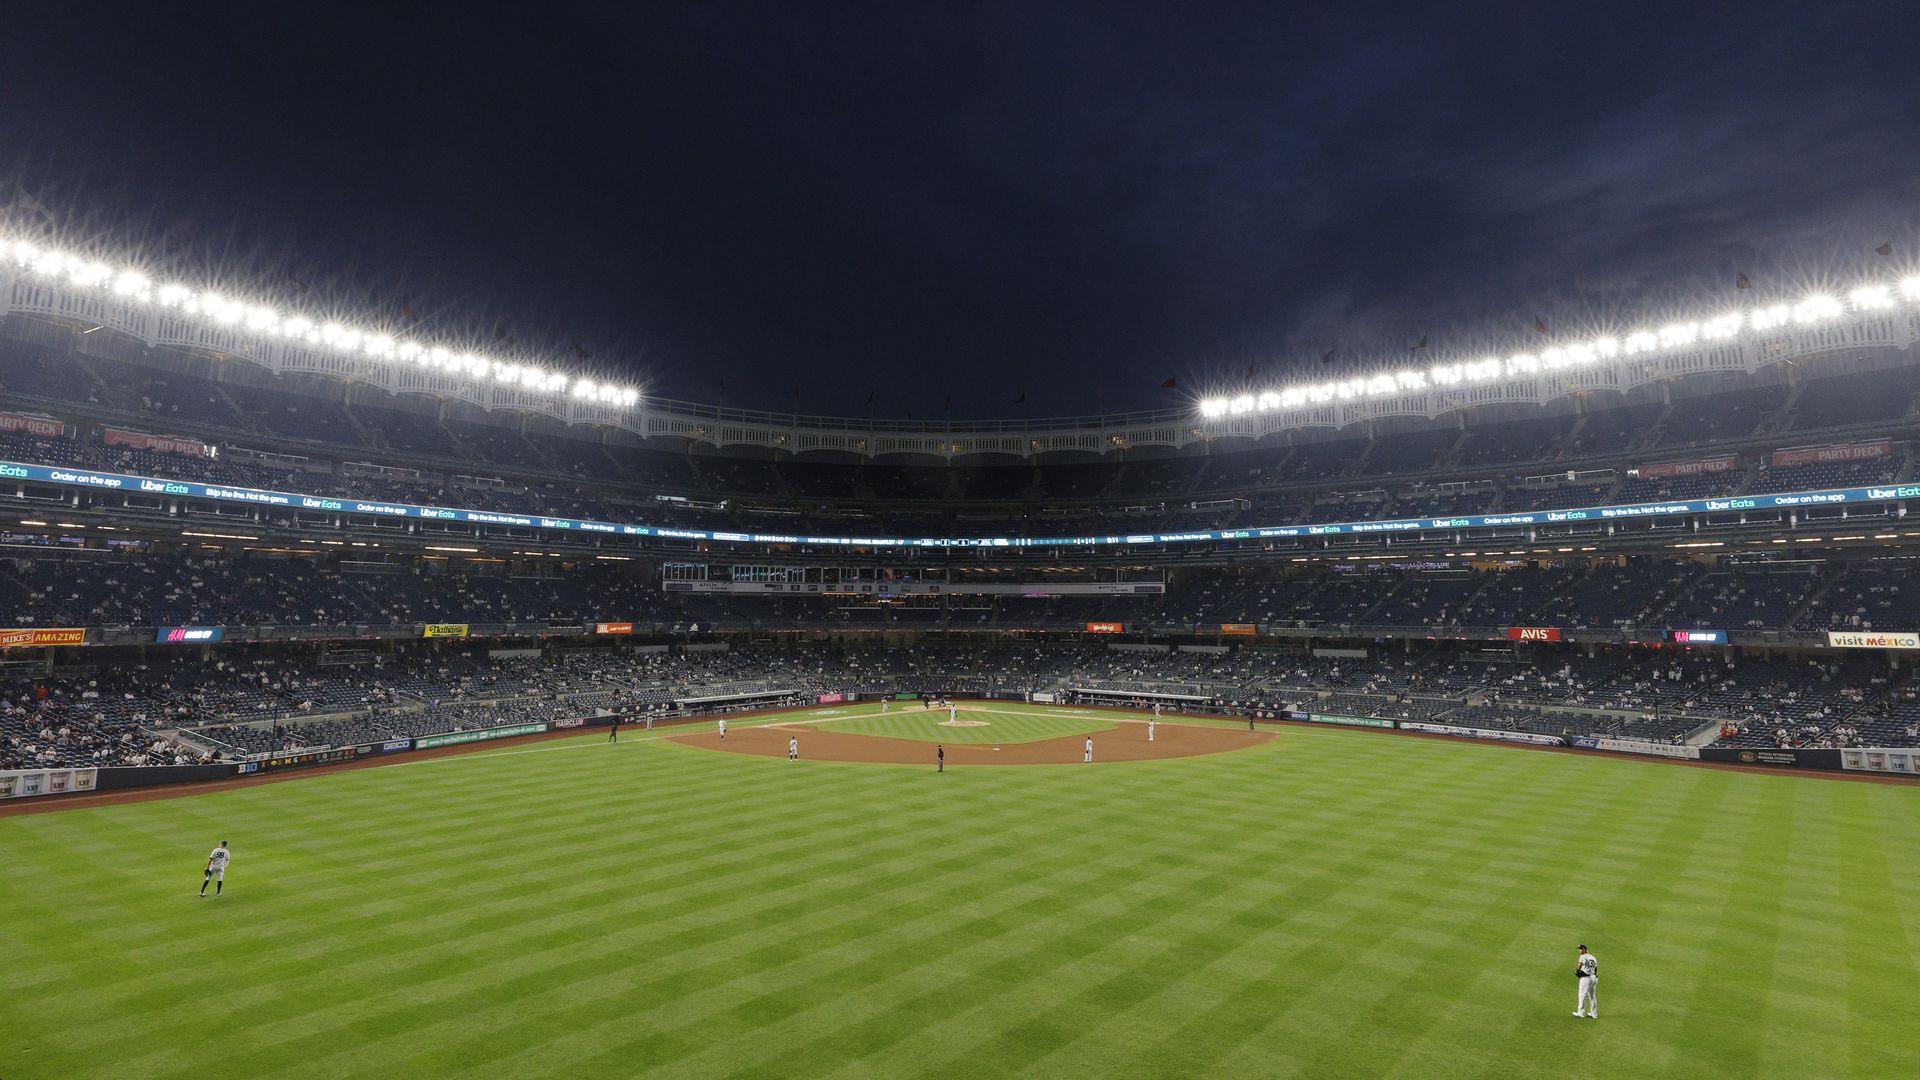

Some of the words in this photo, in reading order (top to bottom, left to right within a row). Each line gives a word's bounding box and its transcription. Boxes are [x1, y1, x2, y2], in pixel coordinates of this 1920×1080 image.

[28, 422, 56, 434] DECK
[147, 438, 174, 450] PARTY
[176, 442, 199, 454] DECK
[1818, 449, 1851, 460] PARTY
[1854, 446, 1882, 456] DECK
[0, 464, 28, 477] Eats
[1676, 463, 1702, 473] PARTY
[1704, 460, 1728, 470] DECK
[51, 472, 77, 480] Order
[90, 476, 104, 484] the
[104, 479, 122, 487] app
[141, 480, 165, 492] Uber
[166, 483, 189, 494] Eats
[206, 488, 220, 498] Skip
[1868, 489, 1896, 498] Uber
[303, 498, 321, 507] Uber
[321, 500, 341, 510] Eats
[420, 508, 438, 517] Uber
[438, 510, 455, 518] Eats
[2, 634, 31, 644] MIKE'S
[35, 634, 80, 642] AMAZING
[1520, 629, 1548, 640] AVIS
[1834, 636, 1863, 646] visit
[555, 719, 583, 728] HAIRCLUB
[384, 741, 409, 750] GEICO
